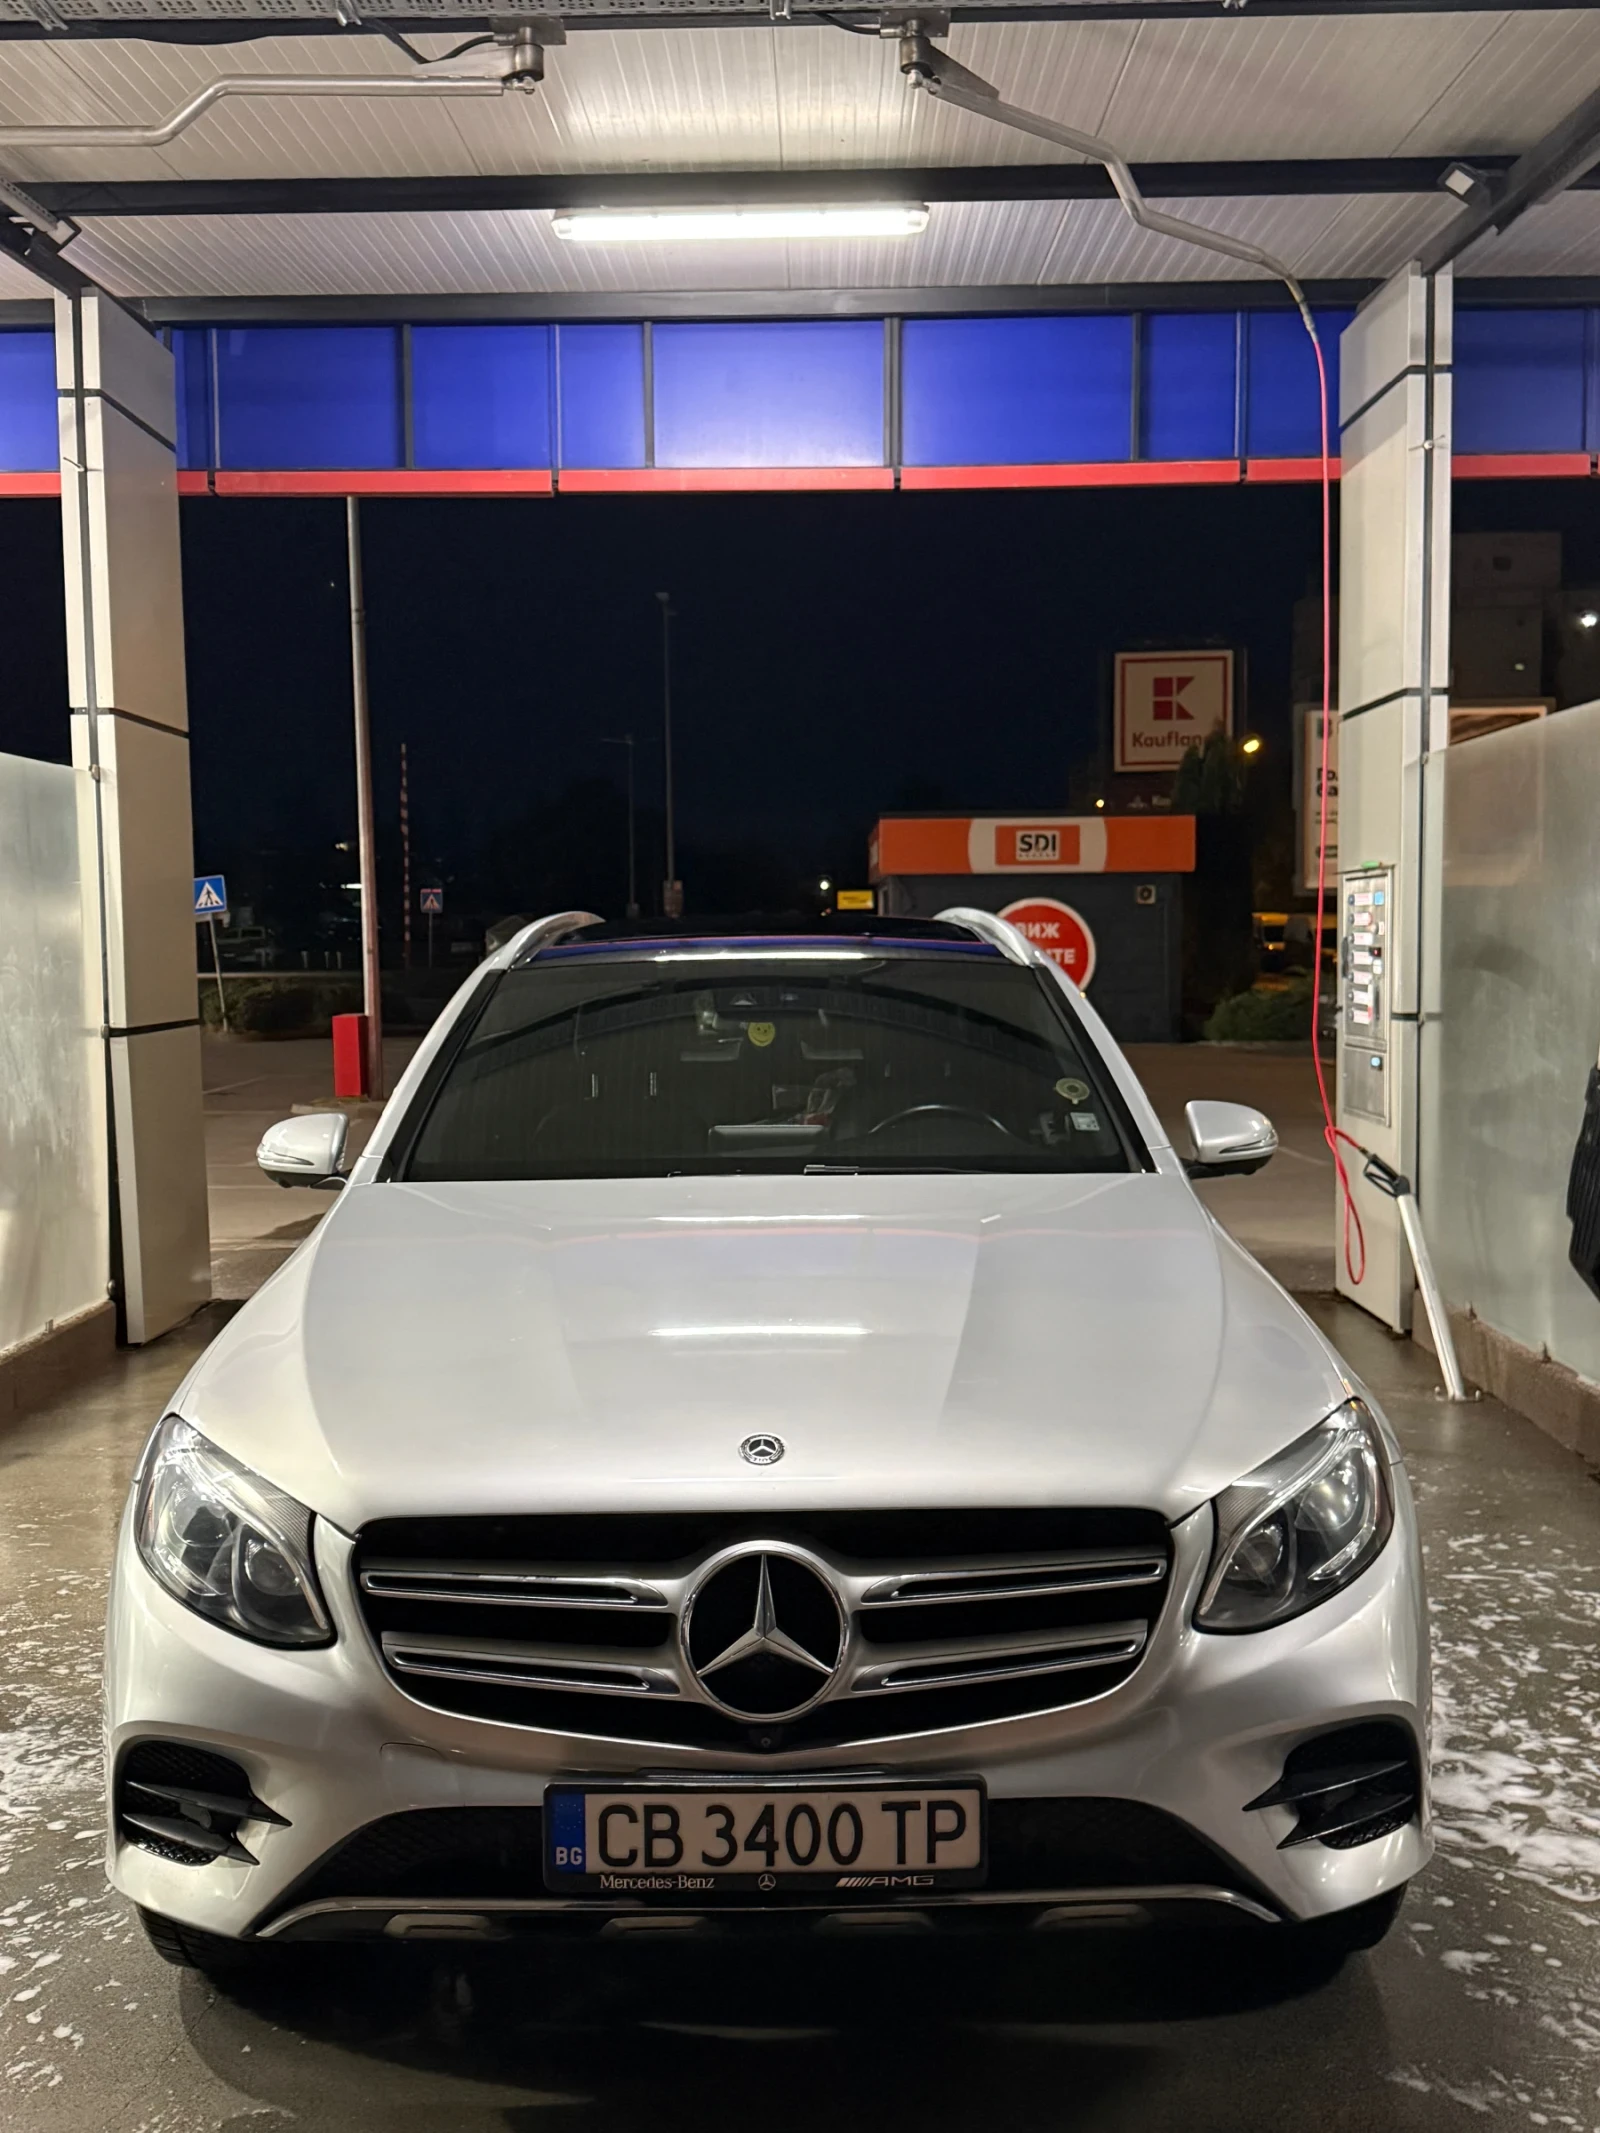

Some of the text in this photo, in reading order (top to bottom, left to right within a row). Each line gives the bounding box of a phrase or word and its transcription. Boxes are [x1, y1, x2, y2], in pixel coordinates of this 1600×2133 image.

[1132, 730, 1206, 748] Kauflan
[1019, 833, 1057, 852] SDI
[598, 1800, 967, 1868] CB 3400 TP
[555, 1846, 583, 1866] BG
[599, 1874, 715, 1890] Mercedes-Benz
[867, 1875, 935, 1887] AMG
